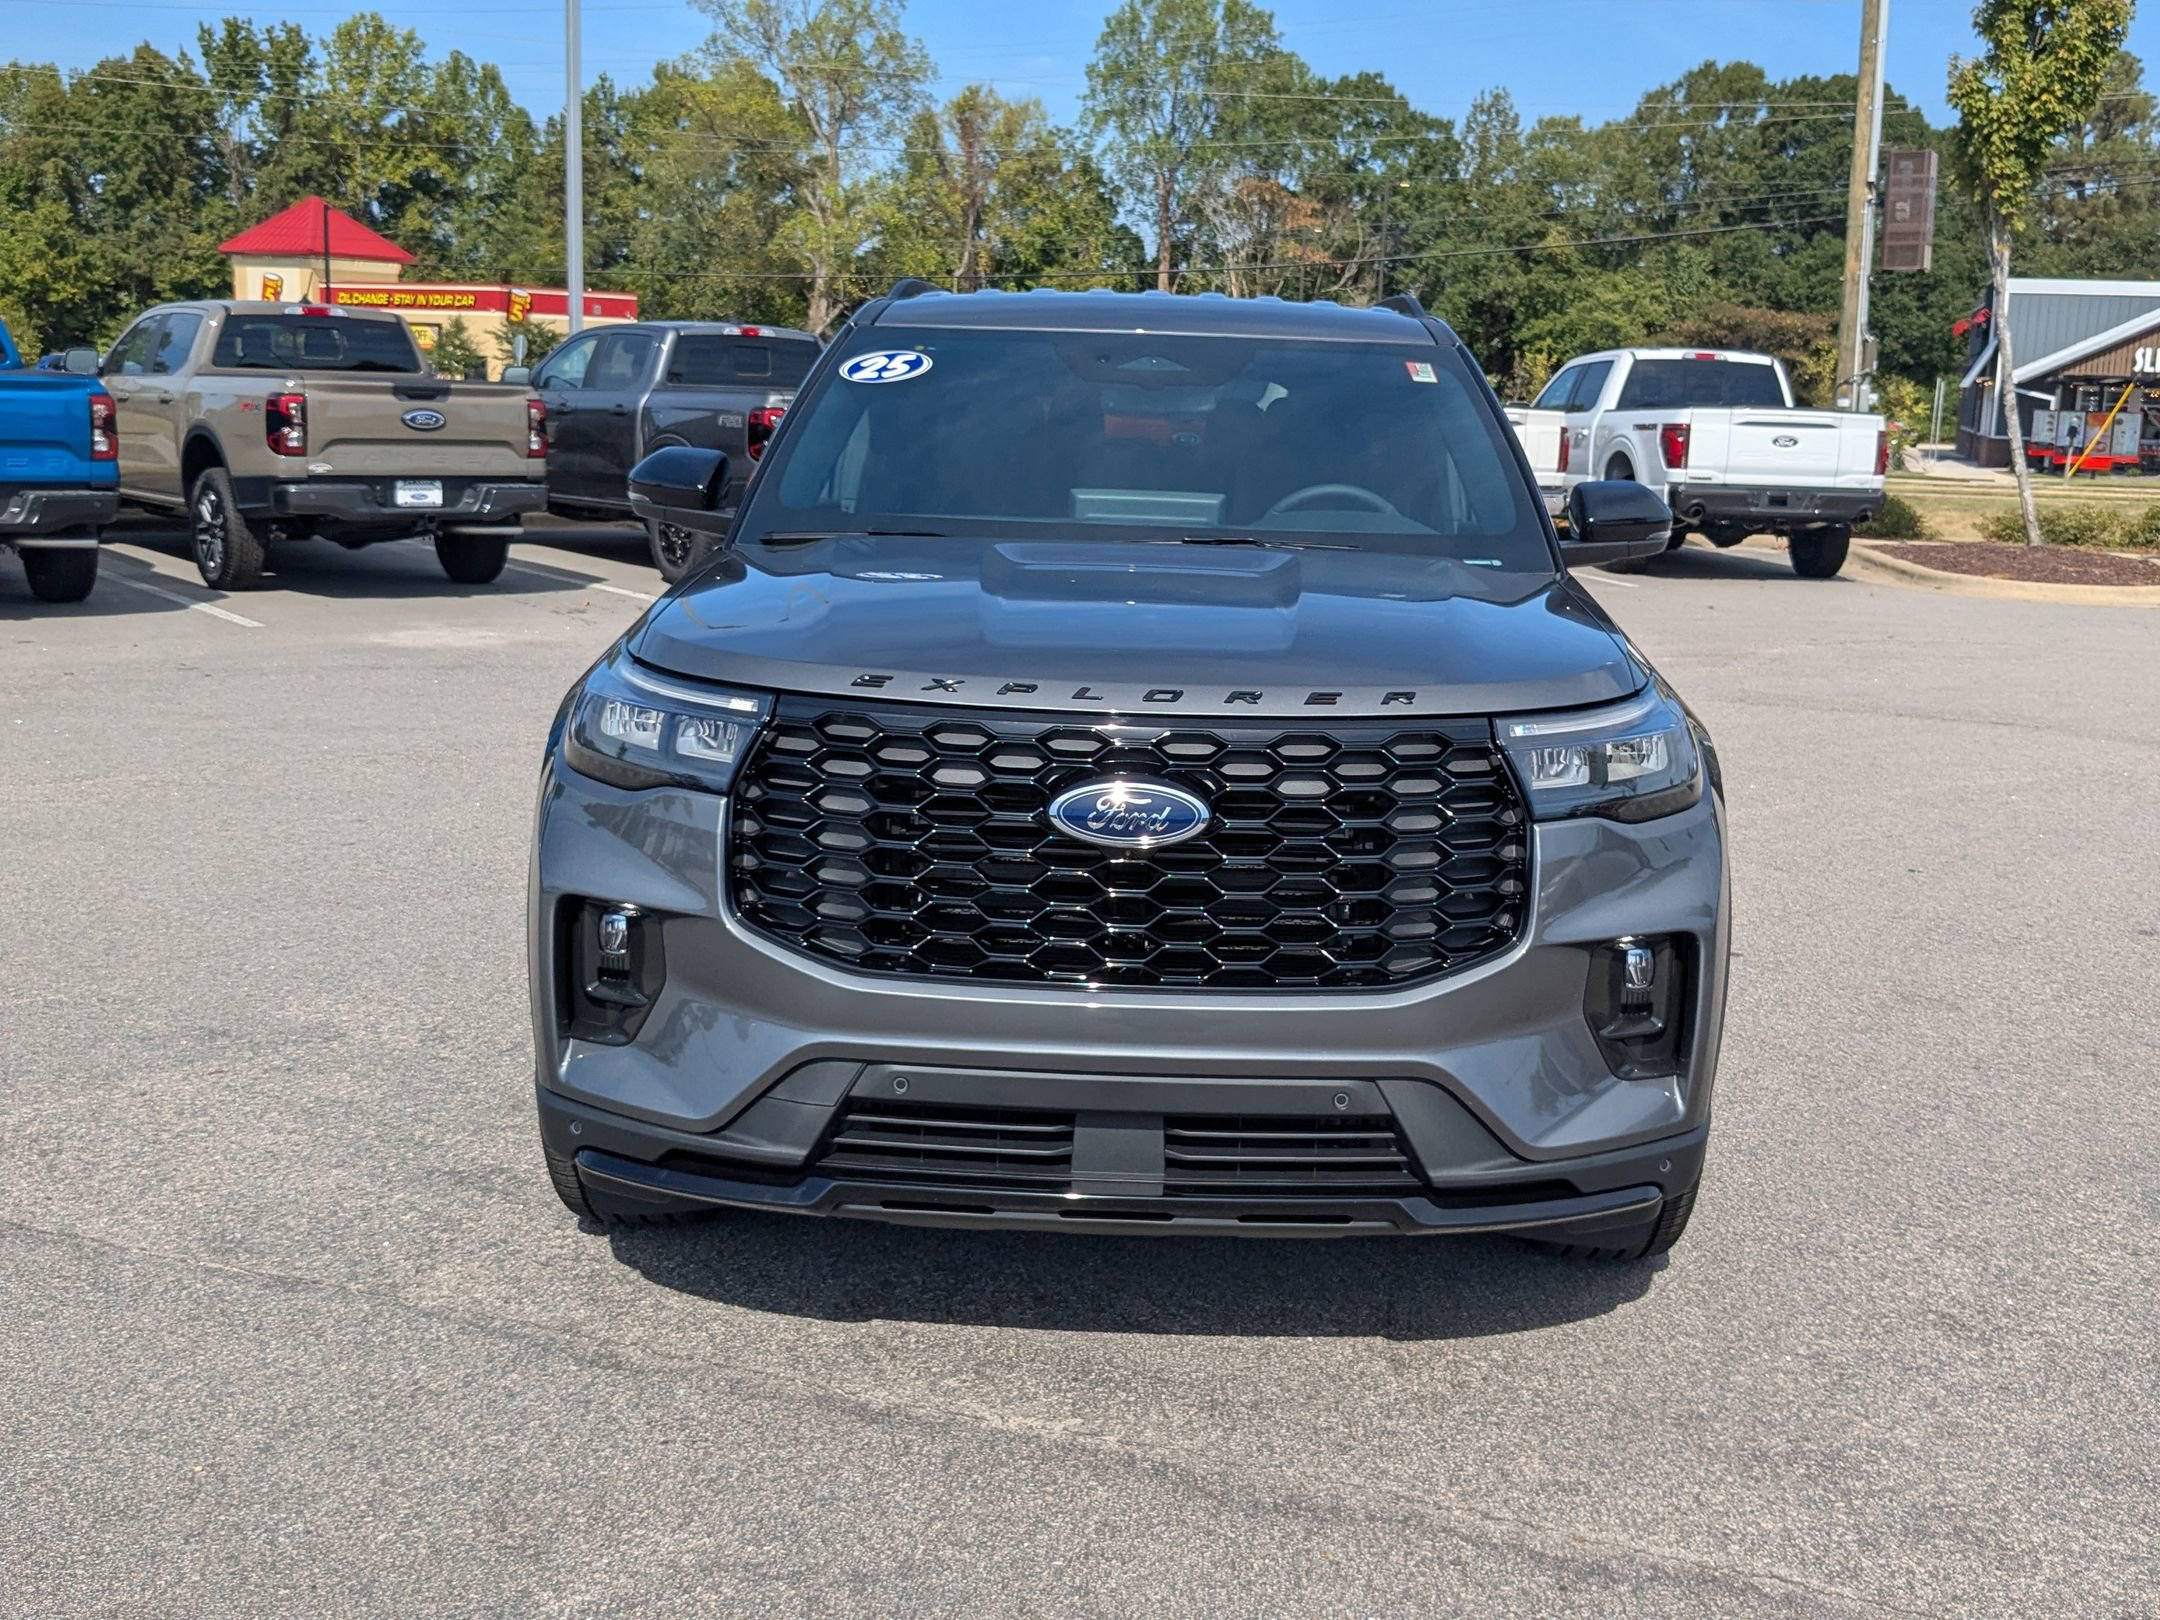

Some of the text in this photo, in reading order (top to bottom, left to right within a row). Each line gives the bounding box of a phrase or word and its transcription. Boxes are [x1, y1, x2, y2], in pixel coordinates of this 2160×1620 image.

[352, 292, 389, 305] CHANGE
[395, 294, 415, 306] STAY
[416, 294, 428, 306] IN
[428, 294, 453, 307] YOUR
[454, 295, 475, 307] CAR
[511, 303, 524, 321] 5
[850, 354, 918, 380] 25
[851, 674, 1417, 706] EXPLORER
[1086, 793, 1172, 832] Ford
